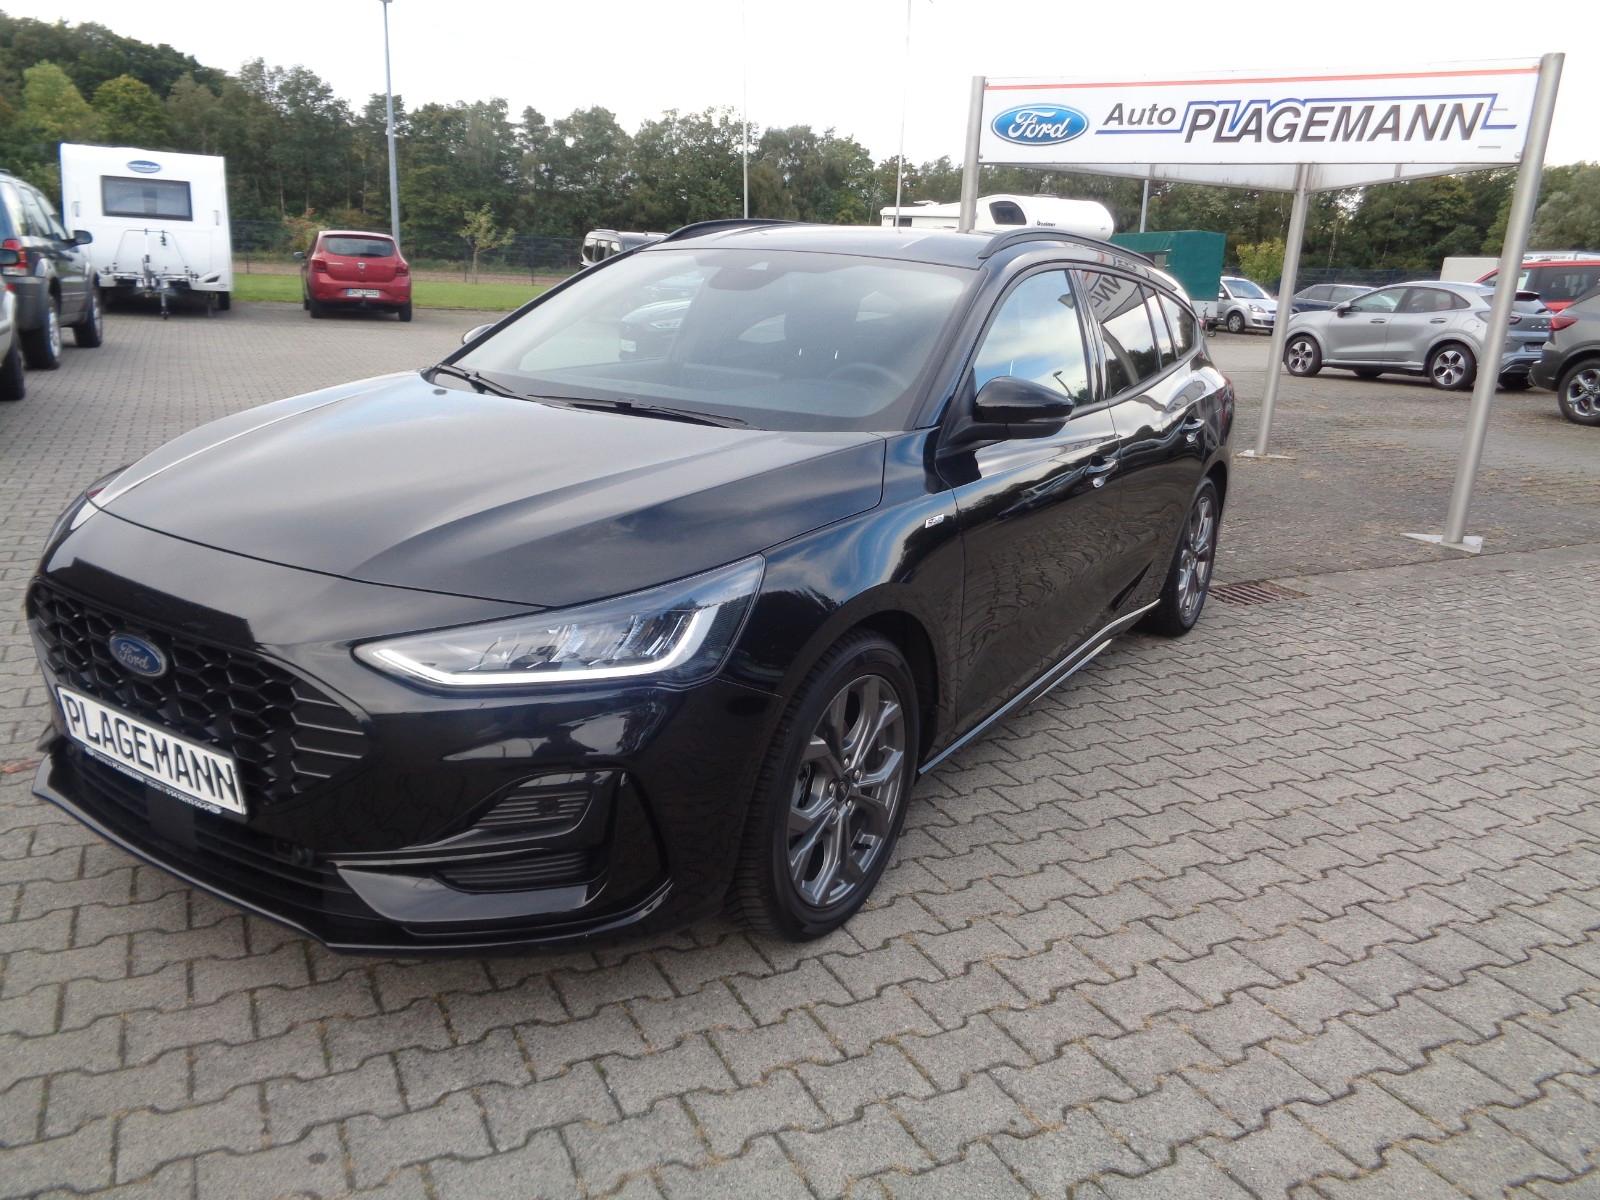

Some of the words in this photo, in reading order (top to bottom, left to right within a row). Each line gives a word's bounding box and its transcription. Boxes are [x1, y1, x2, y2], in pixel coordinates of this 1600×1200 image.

[1007, 110, 1072, 139] Ford
[1102, 102, 1177, 126] Auto
[1184, 101, 1485, 144] PLAGEMANN
[118, 641, 150, 670] Ford
[61, 694, 239, 806] PLAGEMANN
